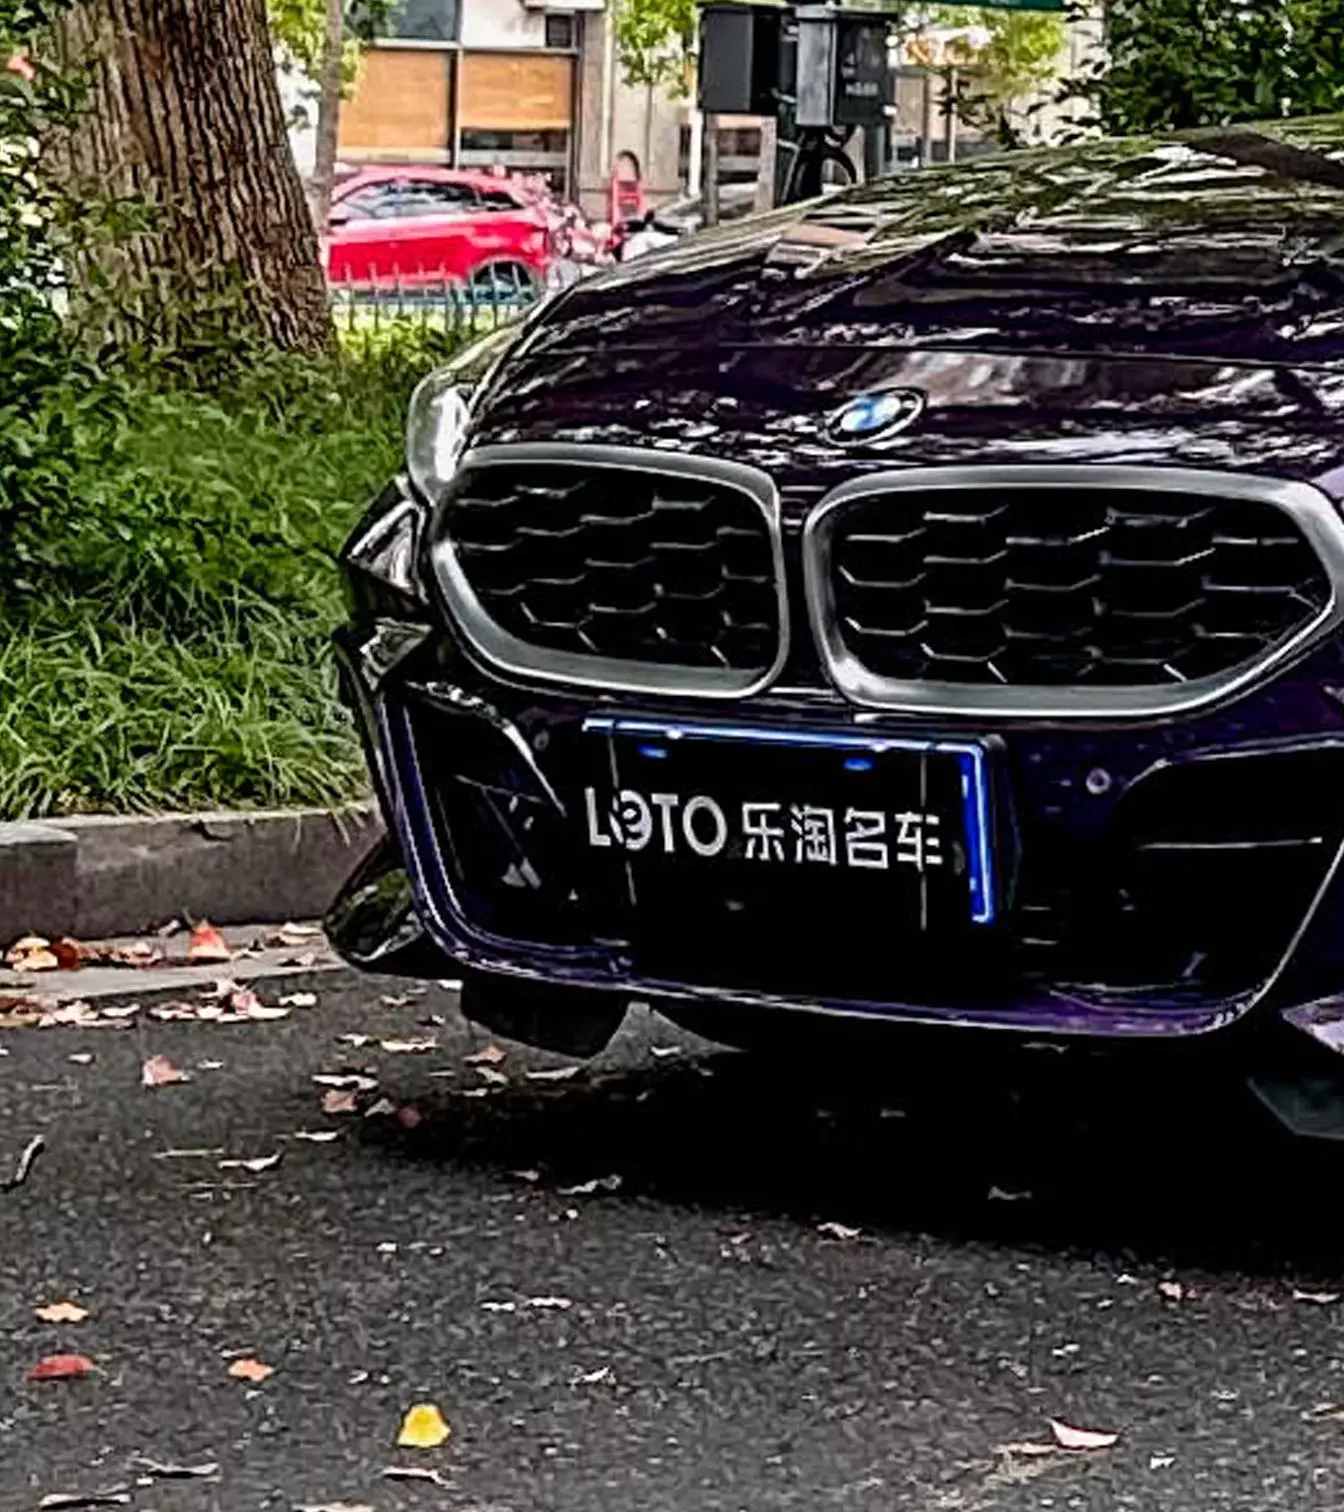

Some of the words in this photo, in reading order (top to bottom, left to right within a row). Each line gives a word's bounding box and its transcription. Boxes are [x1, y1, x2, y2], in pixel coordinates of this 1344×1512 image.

[585, 787, 727, 856] LOTO
[741, 801, 943, 872] 乐淘名车
